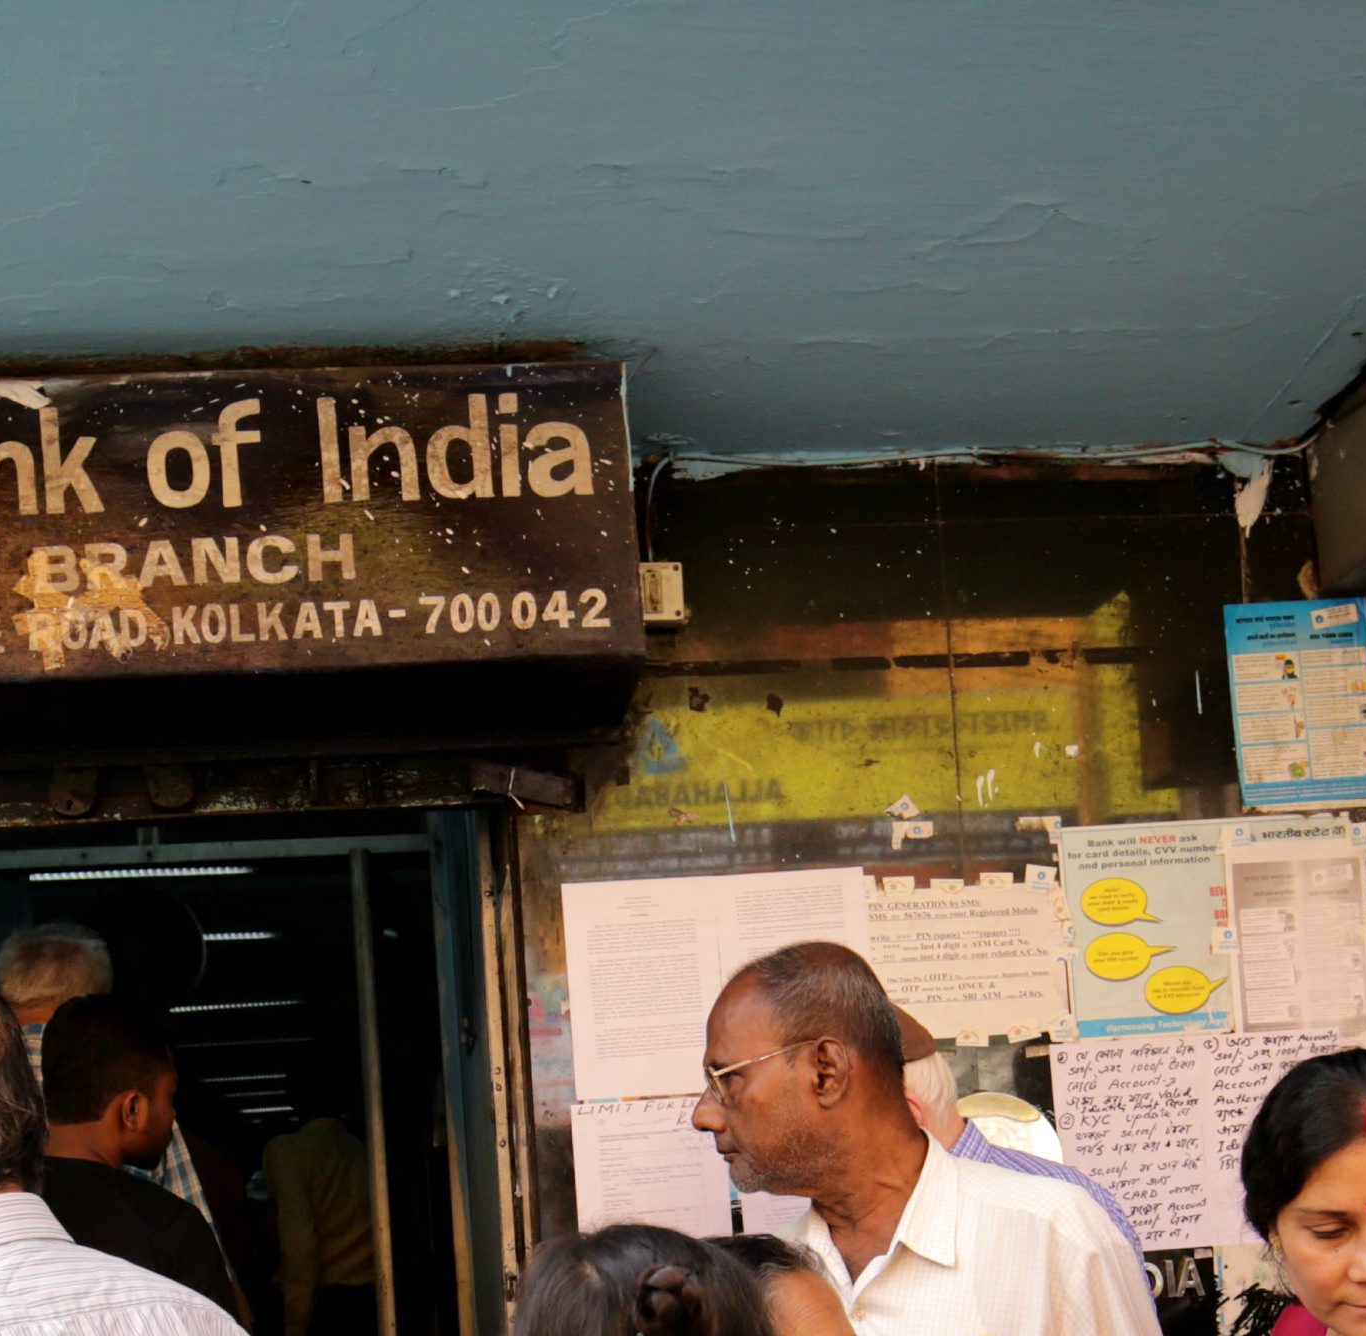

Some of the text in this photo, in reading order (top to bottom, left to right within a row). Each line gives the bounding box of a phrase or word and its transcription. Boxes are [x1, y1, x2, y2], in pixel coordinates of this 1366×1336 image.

[146, 396, 262, 511] of
[317, 391, 595, 505] India
[34, 533, 357, 595] BRANCH
[1088, 834, 1198, 848] Bank will NEVER ask
[1067, 851, 1082, 860] for
[1085, 849, 1110, 859] card
[1112, 847, 1152, 858] details,
[1154, 845, 1177, 855] CVV
[1079, 855, 1211, 871] and personal information
[887, 900, 948, 911] GENERATION
[960, 899, 981, 908] SMS
[868, 913, 887, 921] SMS
[949, 911, 967, 920] your
[969, 907, 1011, 918] Registered
[1012, 906, 1039, 916] Mobile
[920, 938, 1014, 951] last digit ATM Card
[942, 951, 960, 962] digit
[901, 982, 984, 994] OTP ONCE
[982, 991, 1002, 1000] ATM
[1212, 1076, 1268, 1092] Account
[577, 1102, 635, 1116] LIMIT
[1080, 1114, 1112, 1127] KYC
[1122, 1187, 1159, 1200] CARD
